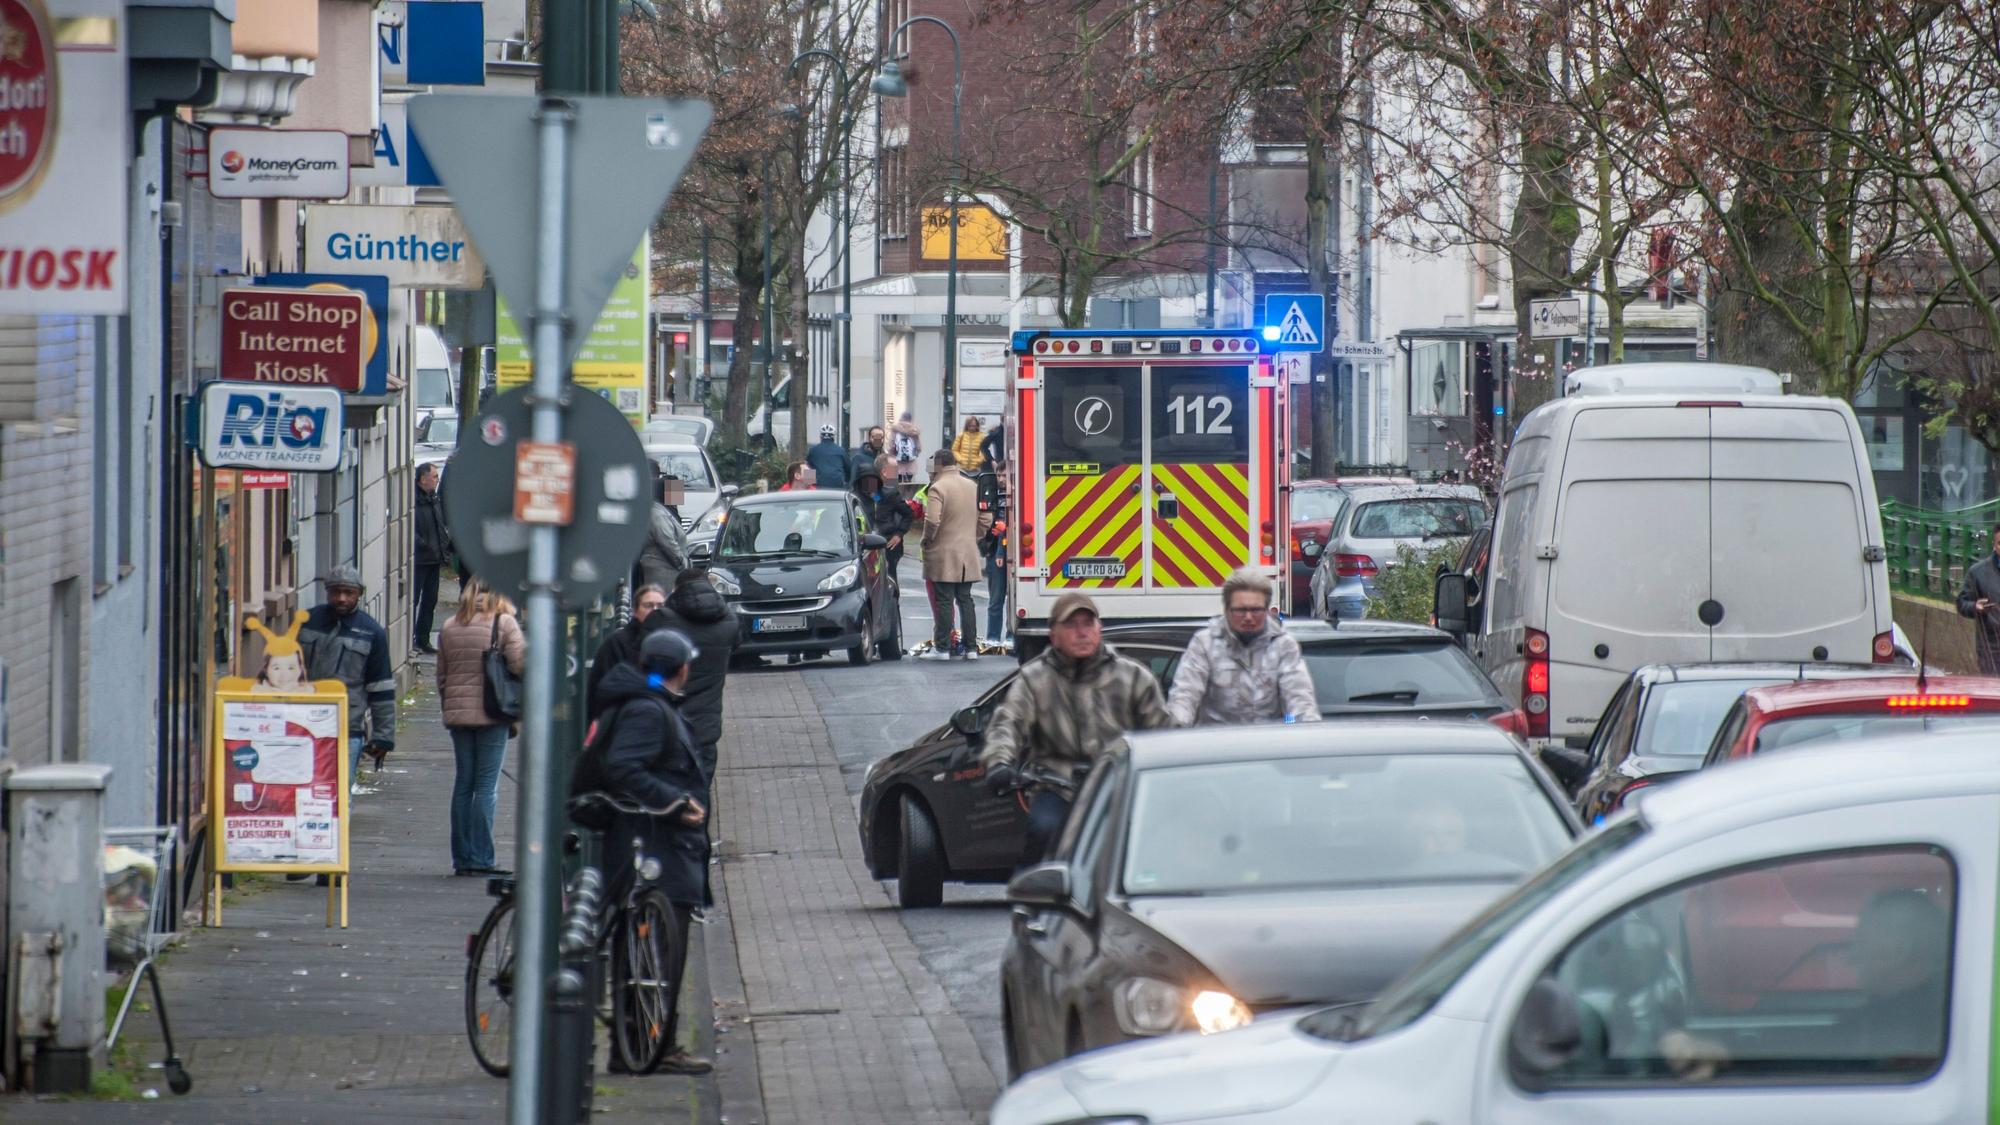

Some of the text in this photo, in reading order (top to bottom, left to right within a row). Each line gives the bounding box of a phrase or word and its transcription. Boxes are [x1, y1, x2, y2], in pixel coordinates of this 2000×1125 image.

[248, 158, 337, 173] MoneyGram
[929, 212, 966, 228] ADC
[327, 232, 465, 262] Günther
[0, 248, 116, 290] IOSK
[228, 299, 358, 329] Call Shop
[240, 331, 346, 354] Internet
[254, 361, 329, 384] Kiosk
[219, 392, 329, 450] Ria
[1166, 395, 1233, 435] 112
[216, 450, 322, 463] MONEY TRANSFER
[1069, 564, 1124, 576] LEV RD 847
[227, 819, 284, 829] EINSTECKEN
[227, 829, 291, 840] & LOSSURFEN
